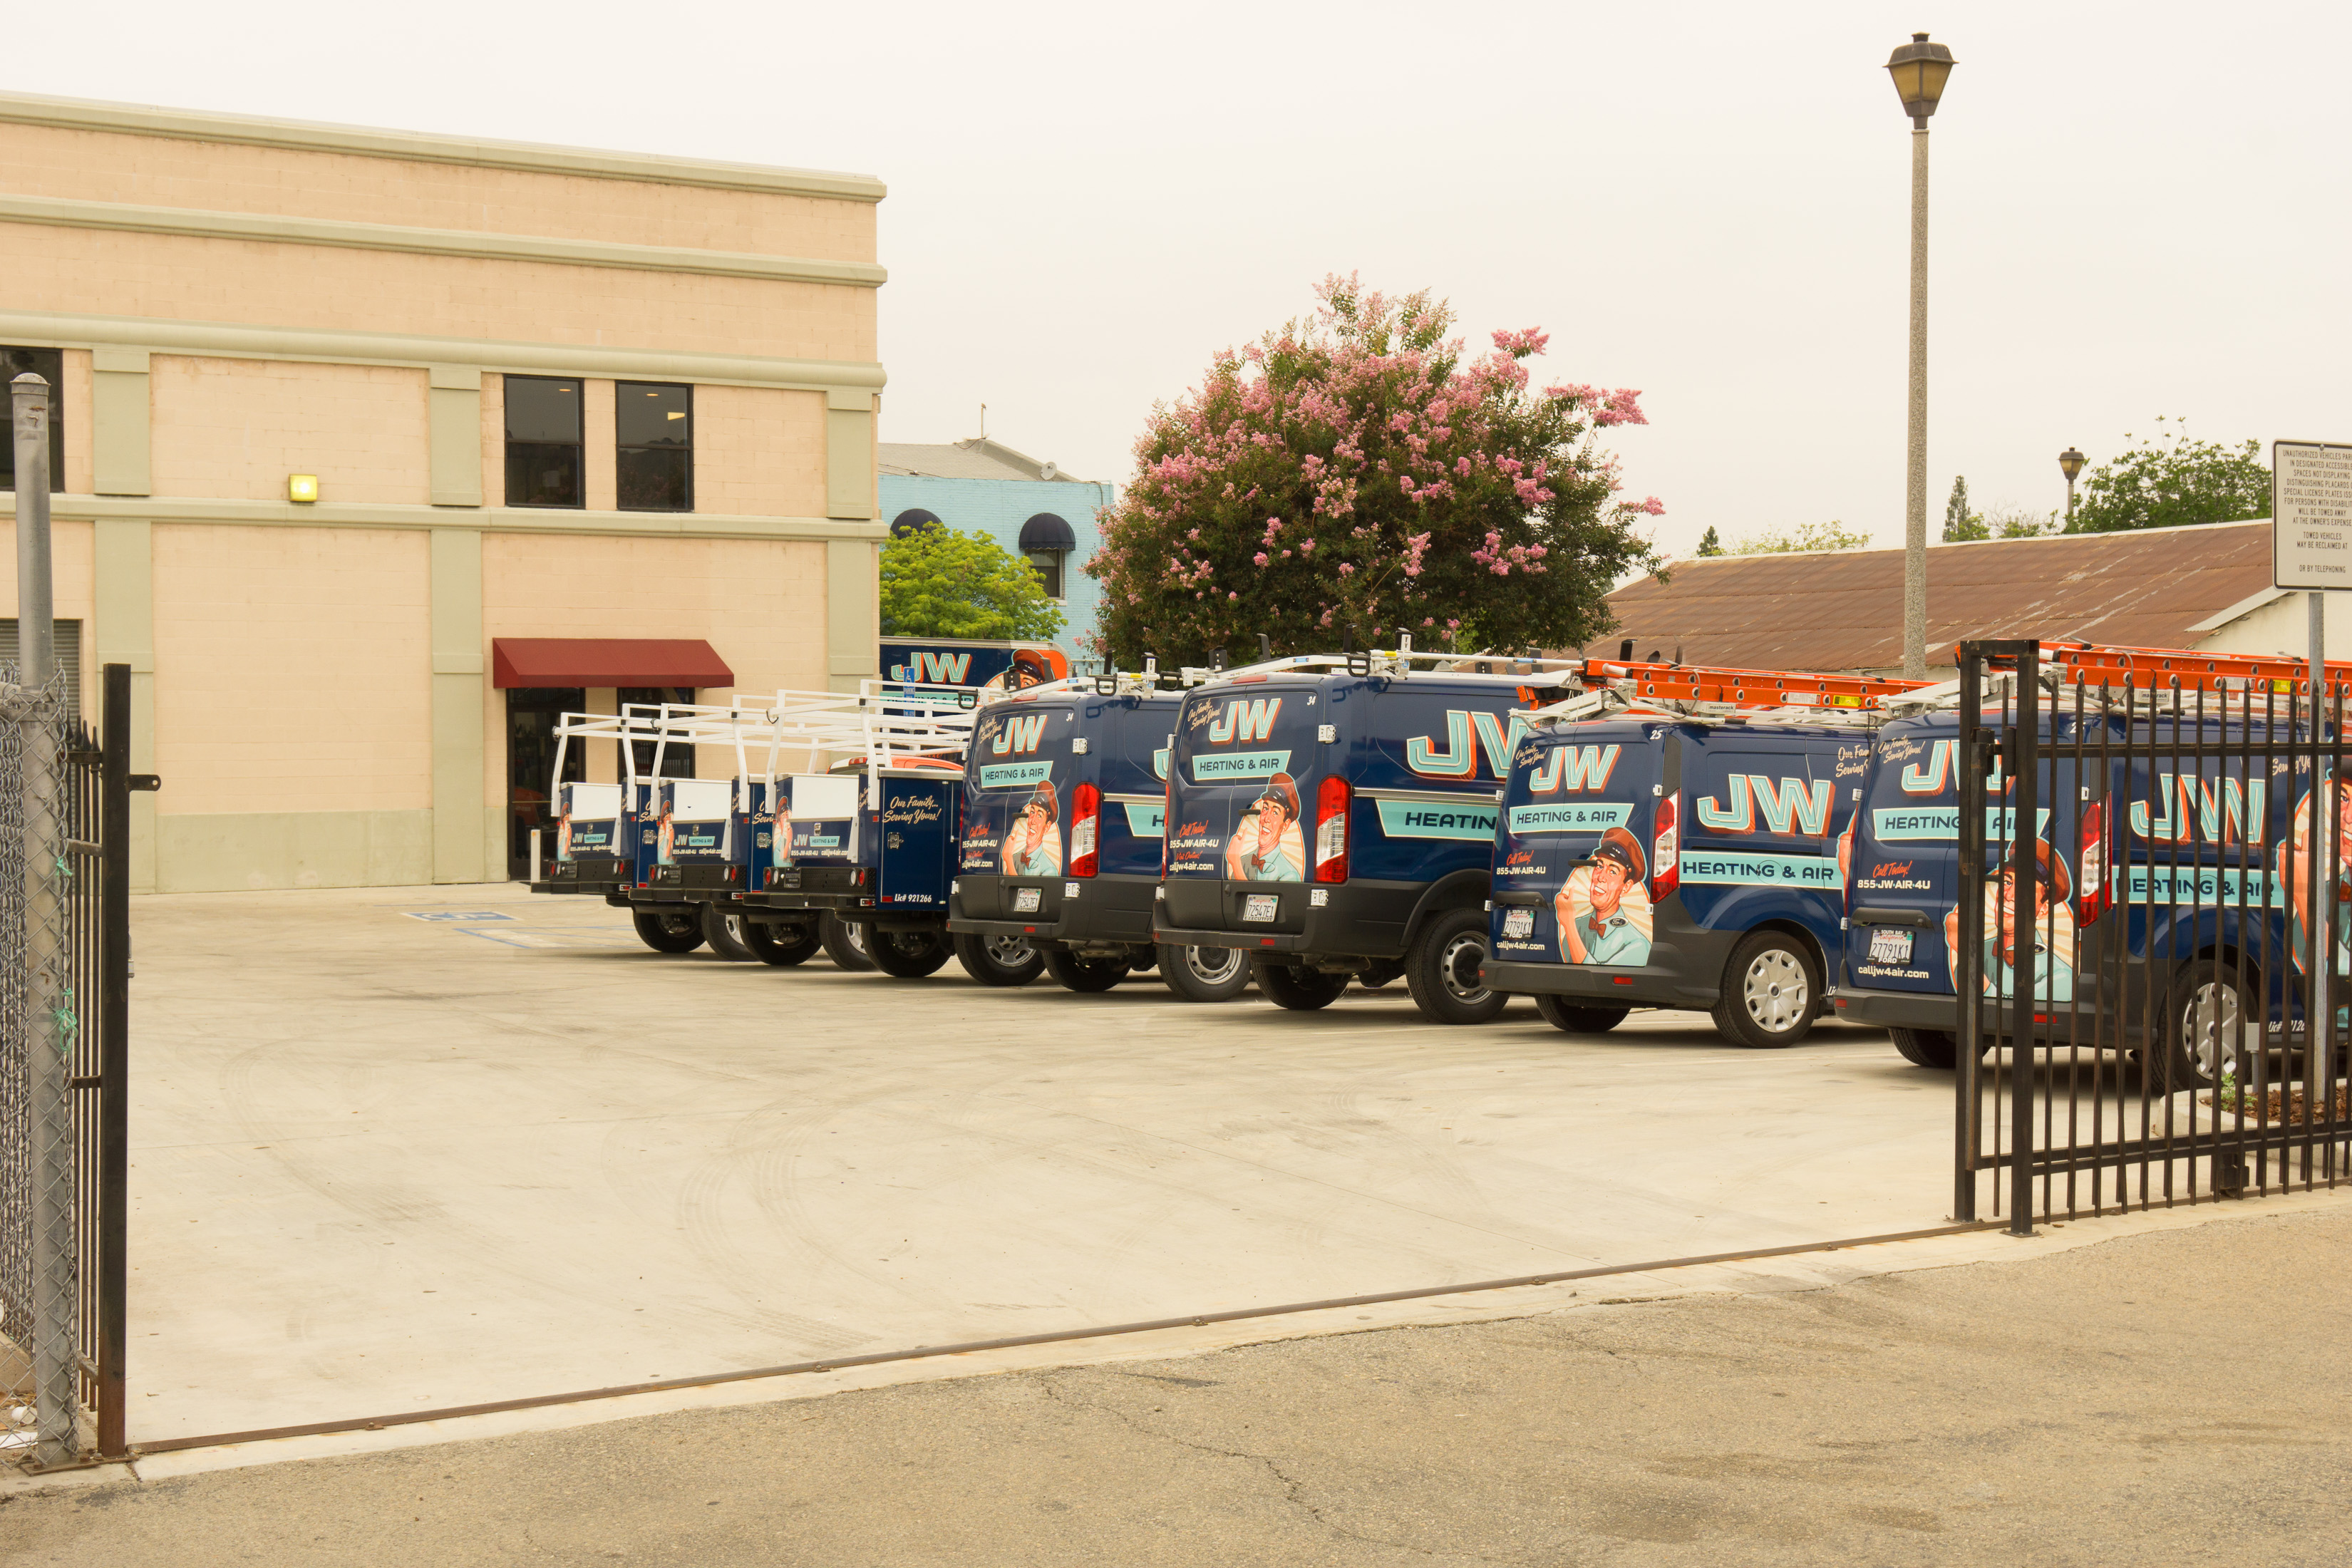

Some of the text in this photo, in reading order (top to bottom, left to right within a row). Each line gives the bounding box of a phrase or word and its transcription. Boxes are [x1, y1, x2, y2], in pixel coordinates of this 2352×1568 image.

[2283, 449, 2318, 458] UNAUTHORIZED
[2319, 452, 2341, 460] VEHICLES
[2296, 460, 2324, 468] DESIGNATED
[2323, 470, 2350, 480] DISPLAYING
[2286, 478, 2323, 488] DISTINGUISHING
[2325, 480, 2349, 489] PLACARDS
[2320, 532, 2342, 540] VEHICLES
[891, 652, 973, 685] JW
[1307, 696, 1316, 706] 34
[1066, 713, 1074, 722] 34
[1209, 698, 1283, 746] JW
[993, 715, 1048, 757] JW
[1650, 730, 1663, 740] 25
[1838, 746, 1853, 761] Our
[1878, 741, 1890, 754] Our
[1883, 750, 1904, 764] Serving
[1904, 741, 1926, 760] Yours!
[1200, 758, 1279, 772] HEATING & AIR
[1529, 745, 1622, 795] JW
[1835, 762, 1864, 778] Serving
[985, 768, 1044, 780] HEATING & AIR
[890, 796, 906, 809] Our
[1697, 773, 1836, 840] JW
[2130, 773, 2266, 845] JW
[882, 808, 942, 824] Serving Yours!
[1405, 812, 1497, 830] HEATIN
[1517, 811, 1617, 825] HEATING & AIR
[1180, 820, 1209, 838] Call Today!
[572, 832, 583, 843] JW
[675, 835, 688, 845] JW
[793, 834, 808, 846] JW
[1506, 850, 1534, 866] Call Today!
[1170, 861, 1214, 872] calljw4air.com
[1683, 862, 1834, 880] HEATING & AIR
[1872, 860, 1913, 878] Call Today!
[894, 893, 932, 902] Lic# 921266
[1247, 904, 1274, 917] 72547E1
[1504, 921, 1532, 934] 27791K1
[1879, 934, 1906, 942] California
[1497, 940, 1545, 950] calljw4air.com
[1870, 942, 1909, 959] 27791K1
[1858, 966, 1929, 979] calljw4air.com
